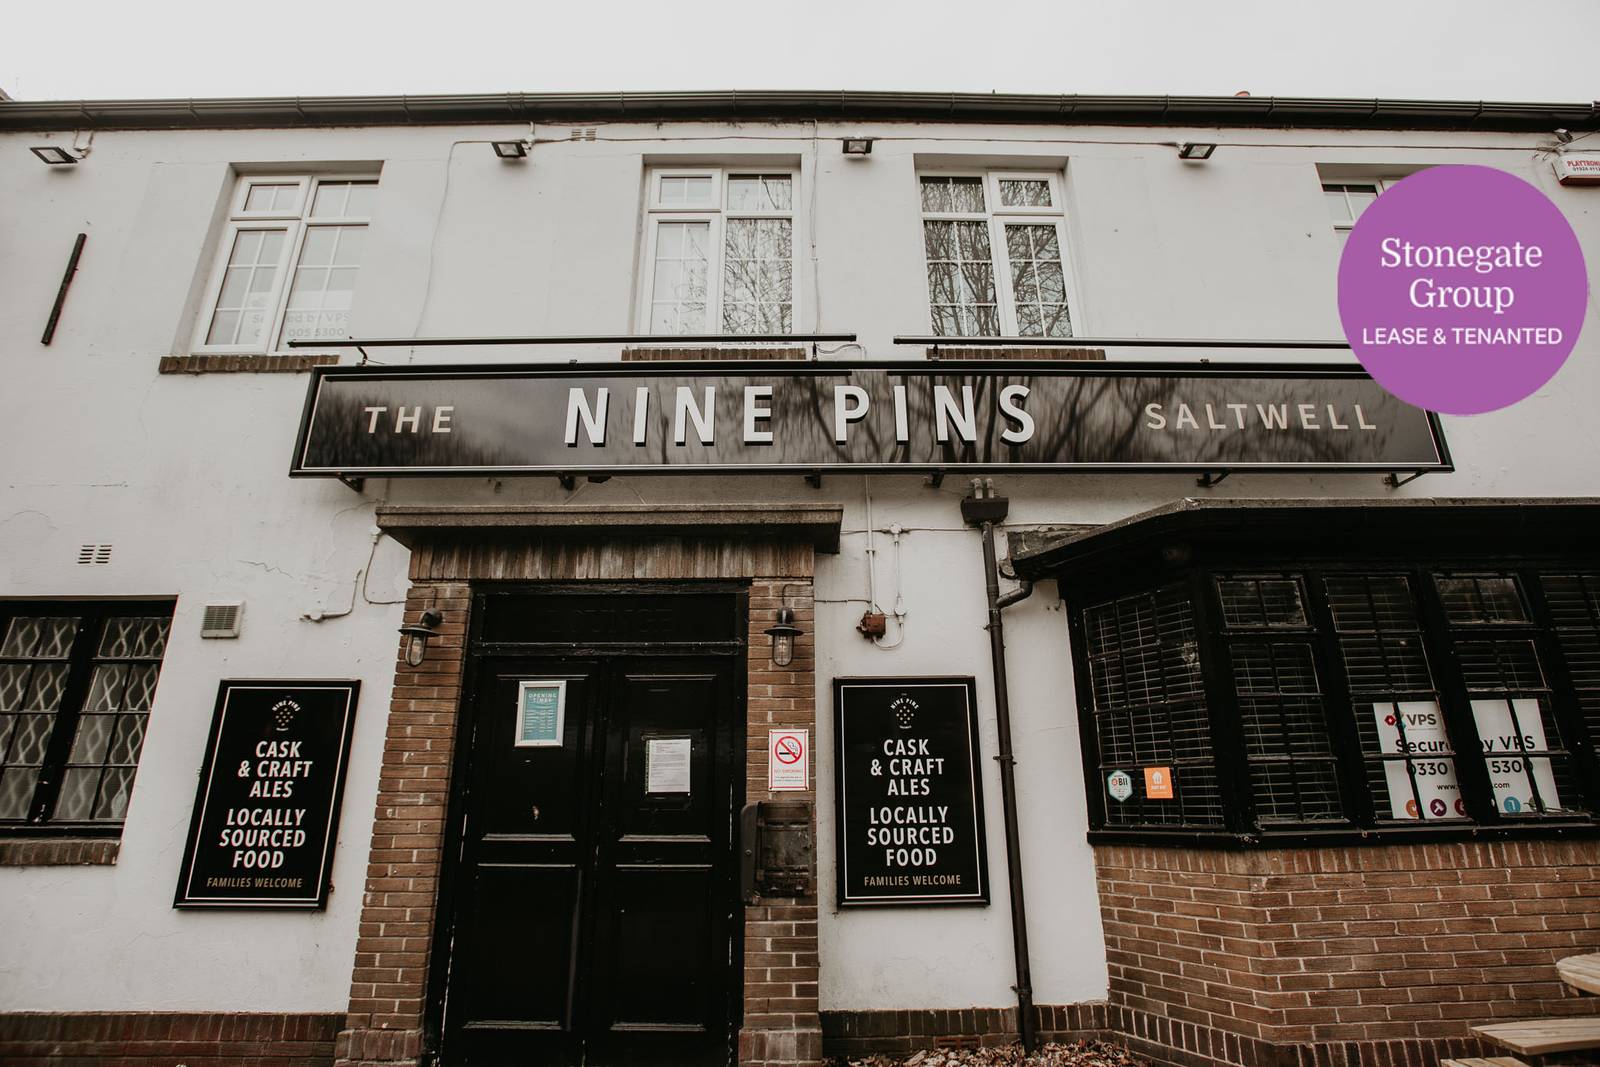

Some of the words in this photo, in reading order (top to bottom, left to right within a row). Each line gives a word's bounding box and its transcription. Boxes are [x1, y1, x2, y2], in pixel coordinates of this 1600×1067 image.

[364, 406, 454, 433] THE
[564, 385, 774, 447] NINE
[834, 384, 1036, 445] PINS
[1145, 403, 1377, 430] SALTWELL
[1406, 713, 1437, 726] VPS
[255, 740, 303, 758] CASK
[883, 738, 930, 756] CASK
[1396, 739, 1450, 752] Secur
[1499, 736, 1535, 750] VPS
[237, 760, 251, 778] &
[257, 760, 313, 778] CRAFT
[870, 758, 882, 776] &
[889, 758, 945, 776] CRAFT
[249, 780, 294, 798] ALES
[887, 778, 930, 796] ALES
[226, 808, 306, 826] LOCALLY
[870, 806, 949, 825] LOCALLY
[219, 829, 306, 847] SOURCED
[867, 826, 955, 846] SOURCED
[232, 850, 284, 868] FOOD
[886, 848, 937, 867] FOOD
[206, 877, 252, 888] FAMILIES
[254, 877, 303, 888] WELCOME
[864, 875, 910, 887] FAMILIES
[912, 874, 961, 886] WELCOME
